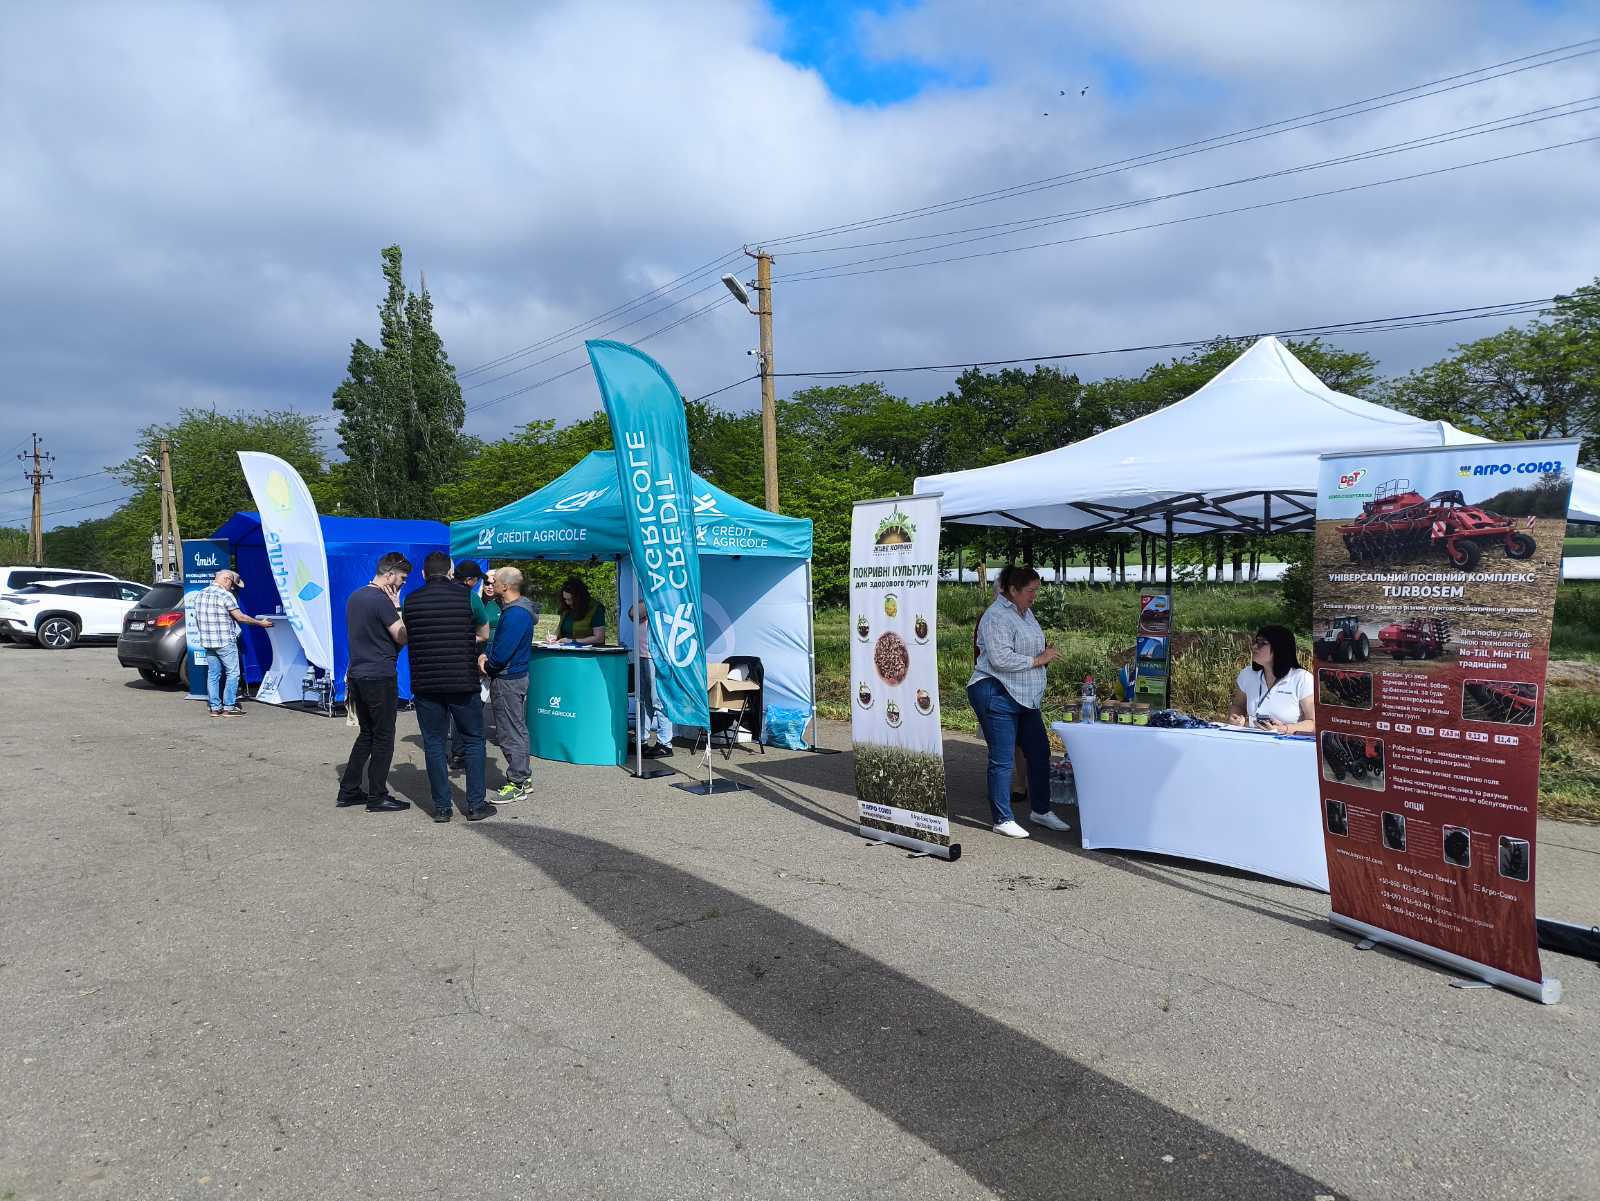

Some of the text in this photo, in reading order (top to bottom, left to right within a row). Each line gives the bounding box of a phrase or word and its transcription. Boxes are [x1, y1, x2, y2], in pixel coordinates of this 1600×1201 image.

[496, 529, 532, 544] CRÉDIT
[533, 528, 587, 542] AGRICOLE
[711, 524, 754, 537] CRÉDIT
[713, 537, 769, 549] AGRICOLE
[853, 564, 933, 579] ПОКРИВНІ КУЛЬТУРИ
[1328, 571, 1536, 583] УНІВЕРСАЛЬНИЙ ПОСІВНИЙ КОМПЛЕКС
[855, 581, 868, 589] для
[869, 580, 905, 589] здорового
[1382, 585, 1464, 598] TURBOSEM
[1477, 630, 1502, 638] посіву
[1459, 660, 1508, 670] традиційна
